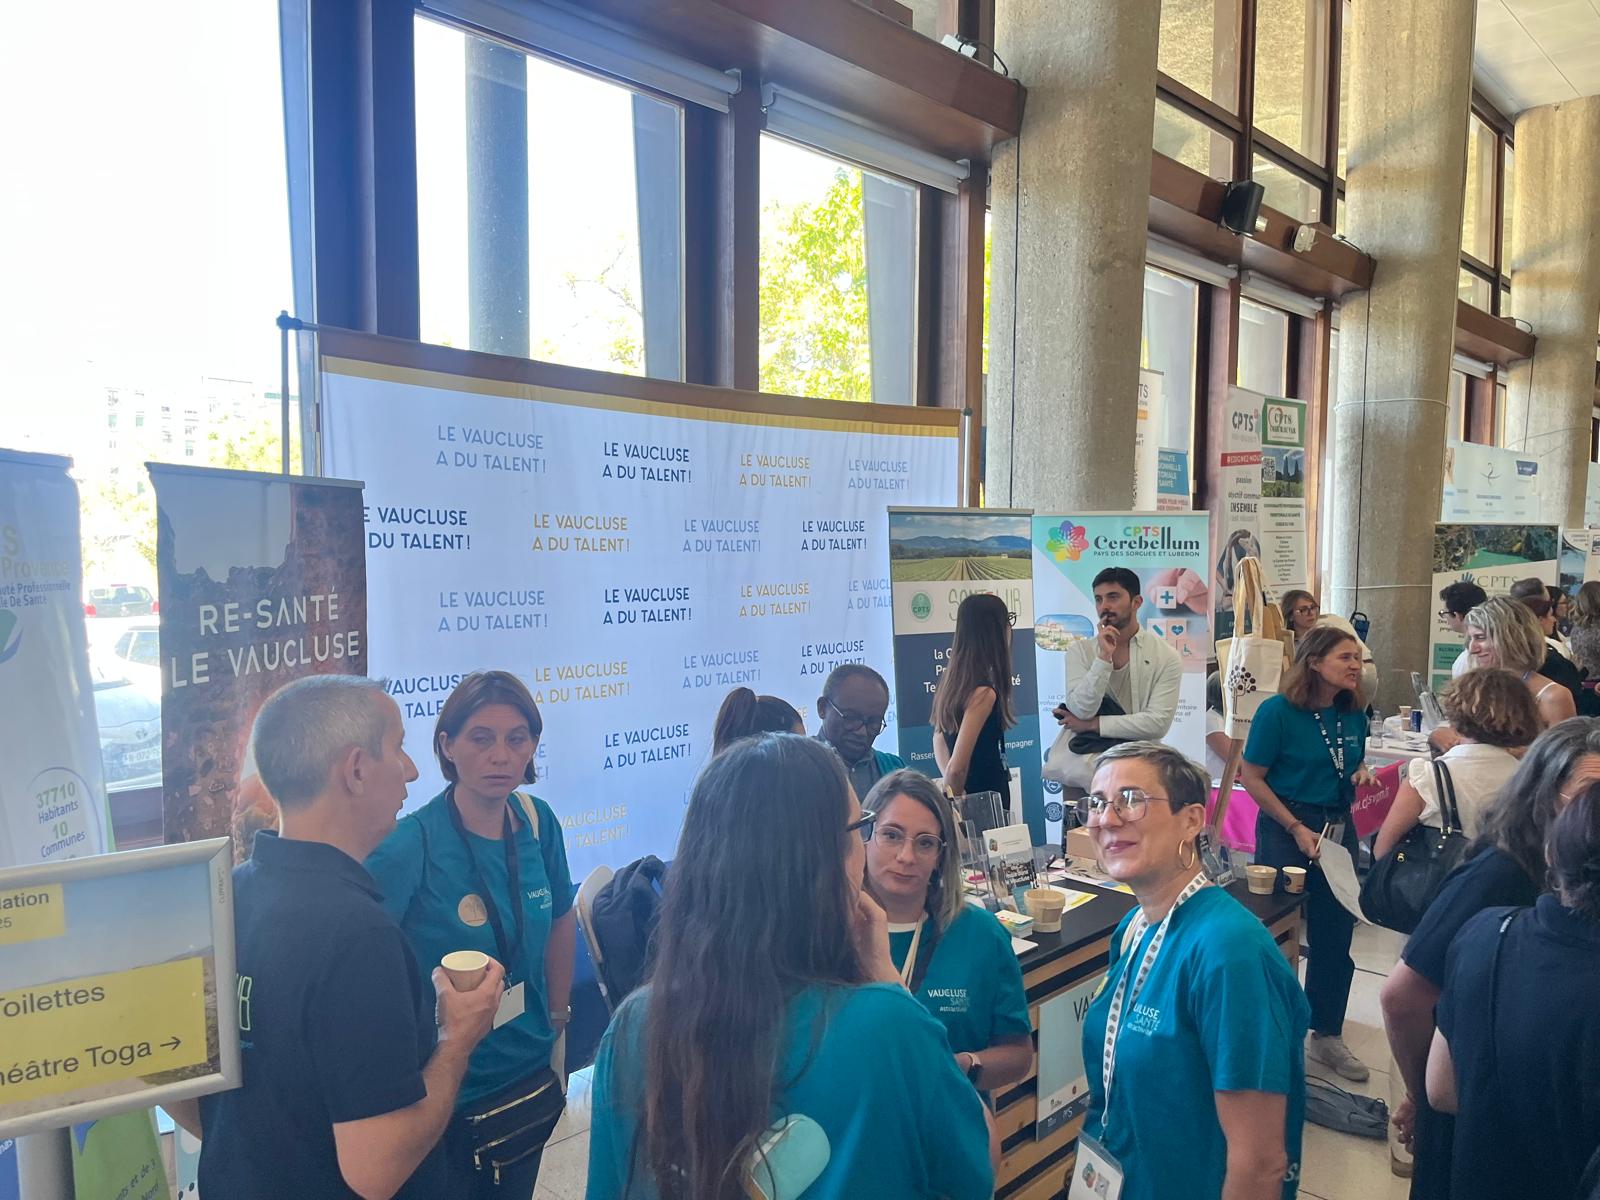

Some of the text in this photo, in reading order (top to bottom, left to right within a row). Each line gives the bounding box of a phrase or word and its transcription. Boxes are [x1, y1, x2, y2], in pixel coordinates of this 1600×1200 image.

[1232, 411, 1253, 432] CPTS
[438, 425, 544, 450] LE VAUCLUSE
[436, 450, 448, 466] A
[454, 452, 478, 469] DU
[604, 441, 690, 463] LE VAUCLUSE
[740, 454, 810, 469] LE VAUCLUSE
[849, 459, 908, 473] LE VAUCLUSE
[602, 464, 613, 478] A
[617, 465, 636, 480] DU
[739, 473, 747, 486] A
[752, 474, 766, 487] DU
[848, 478, 855, 489] A
[857, 478, 871, 490] DU
[378, 506, 468, 526] VAUCLUSE
[534, 513, 628, 531] LE VAUCLUSE
[684, 518, 760, 533] LE VAUCLUSE
[802, 520, 865, 533] LE VAUCLUSE
[1123, 526, 1160, 537] CPTS
[369, 532, 395, 549] DU
[532, 536, 543, 551] A
[549, 537, 569, 551] DU
[683, 539, 692, 553] A
[696, 539, 712, 553] DU
[801, 538, 809, 551] A
[811, 538, 826, 551] DU
[1094, 526, 1200, 550] Cerebellum
[2, 556, 70, 579] Provence
[740, 582, 810, 598] LE VAUCLUSE
[848, 579, 890, 592] LE VAUCL
[440, 590, 545, 608] LE VAUCLUSE
[604, 587, 690, 603] LE VAUCLUSE
[847, 596, 892, 610] A DU TALE
[200, 586, 339, 636] RE-SANTÉ
[603, 611, 613, 625] A
[617, 609, 637, 624] DU
[739, 605, 748, 617] A
[751, 604, 766, 617] DU
[912, 605, 930, 613] CPTS
[437, 616, 451, 632] A
[456, 615, 481, 632] DU
[801, 640, 864, 657] LE VAUCLUSE
[934, 648, 943, 660] la
[171, 630, 360, 689] LE VAUCLUSE
[684, 650, 759, 669] LE VAUCLUSE
[535, 662, 628, 682] LE VAUCLUSE
[800, 664, 807, 676] A
[810, 662, 825, 674] DU
[682, 677, 692, 689] A
[695, 675, 711, 688] DU
[535, 690, 544, 705] A
[549, 688, 570, 703] DU
[405, 700, 443, 719] TALE
[605, 723, 689, 748] LE VAUCLUSE
[603, 757, 613, 770] A
[617, 752, 637, 768] DU
[36, 782, 76, 809] 37710
[38, 800, 80, 824] Habitants
[52, 821, 68, 839] 10
[41, 831, 86, 858] Communes
[0, 892, 49, 910] ation
[927, 988, 967, 998] VAUCLUSE
[85, 1041, 152, 1067] Toga
